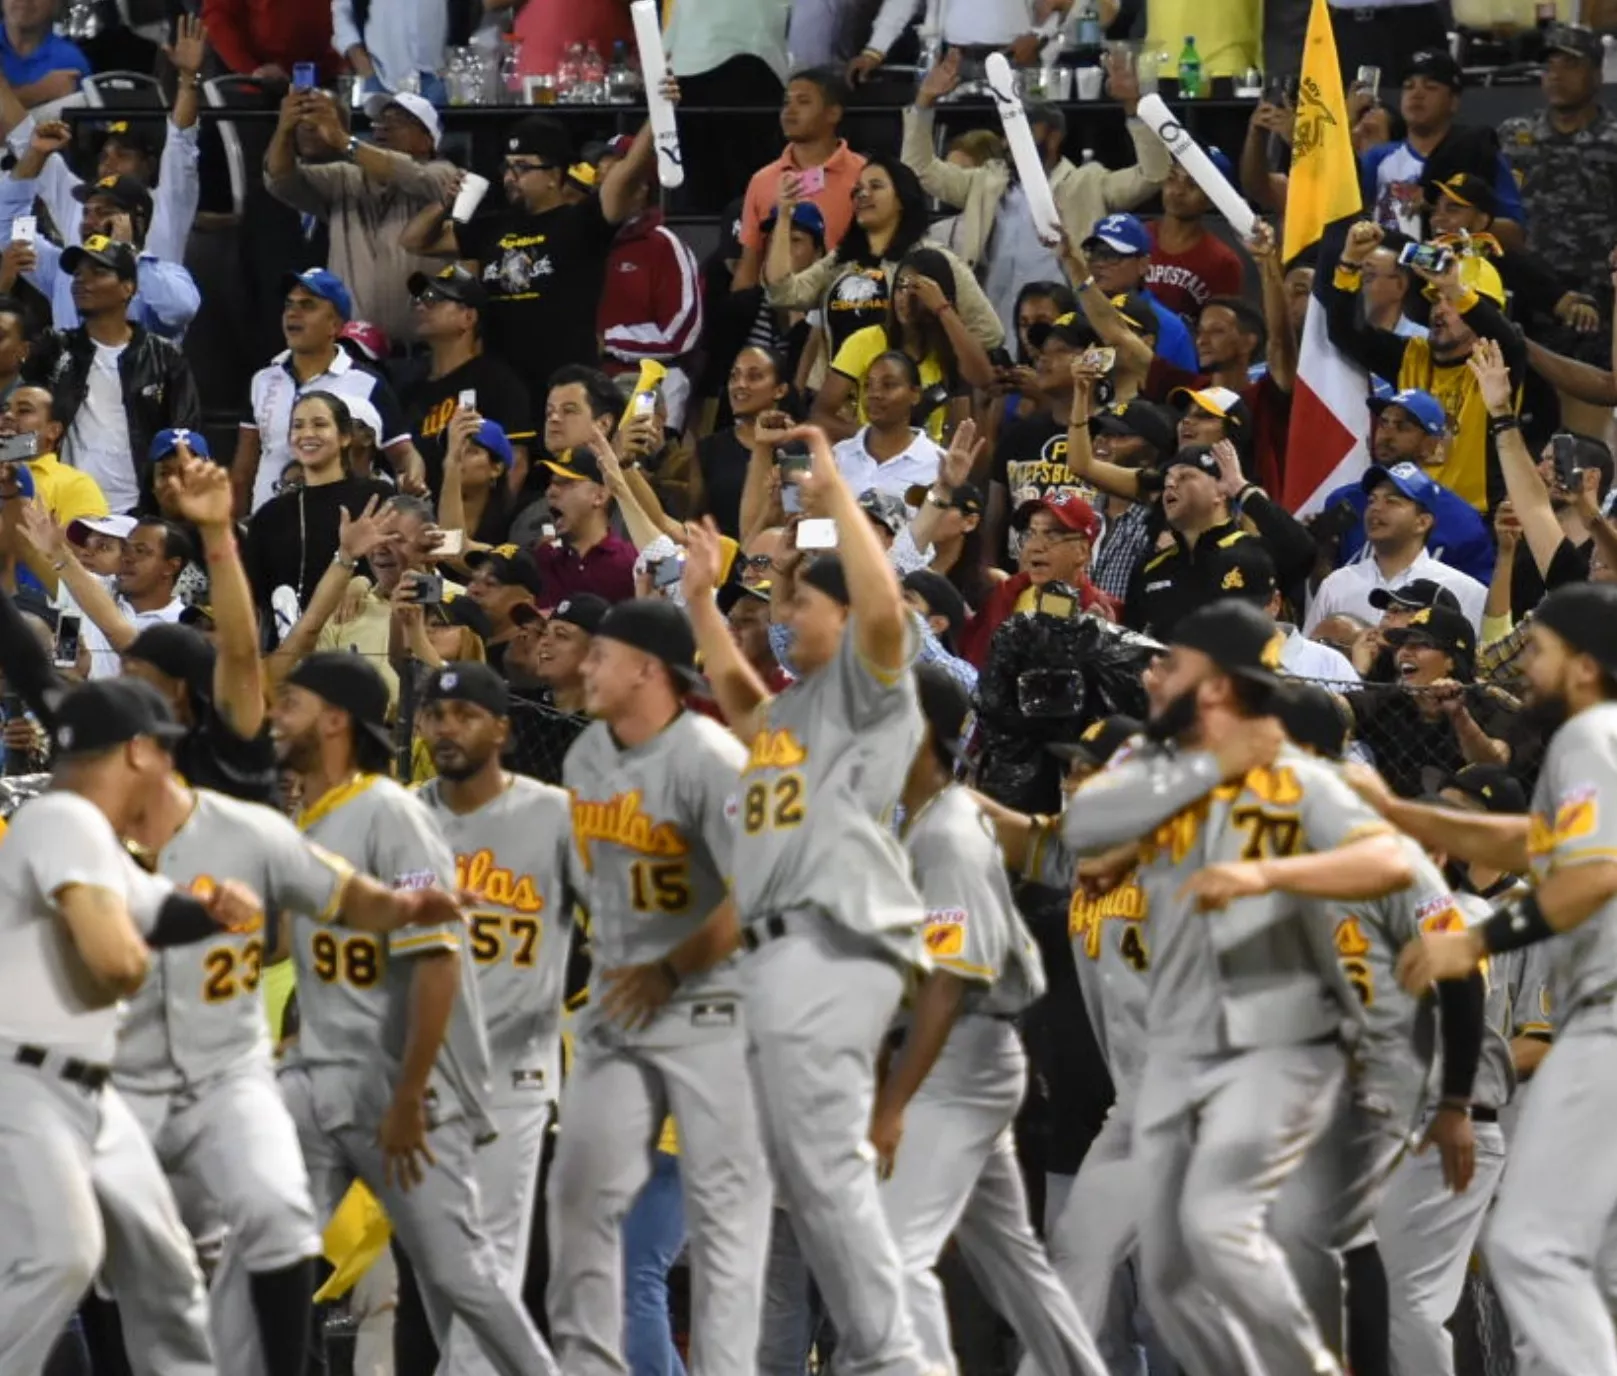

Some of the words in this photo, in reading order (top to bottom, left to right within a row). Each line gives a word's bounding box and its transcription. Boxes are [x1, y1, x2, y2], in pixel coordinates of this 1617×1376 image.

[1145, 263, 1211, 305] OPOSTALE
[571, 787, 690, 875] guilas
[744, 774, 806, 837] 82
[455, 848, 545, 914] ilas
[629, 859, 691, 915] 15
[203, 936, 264, 1005] 23
[312, 929, 380, 990] 98
[468, 912, 545, 969] 57
[1120, 921, 1151, 972] 4
